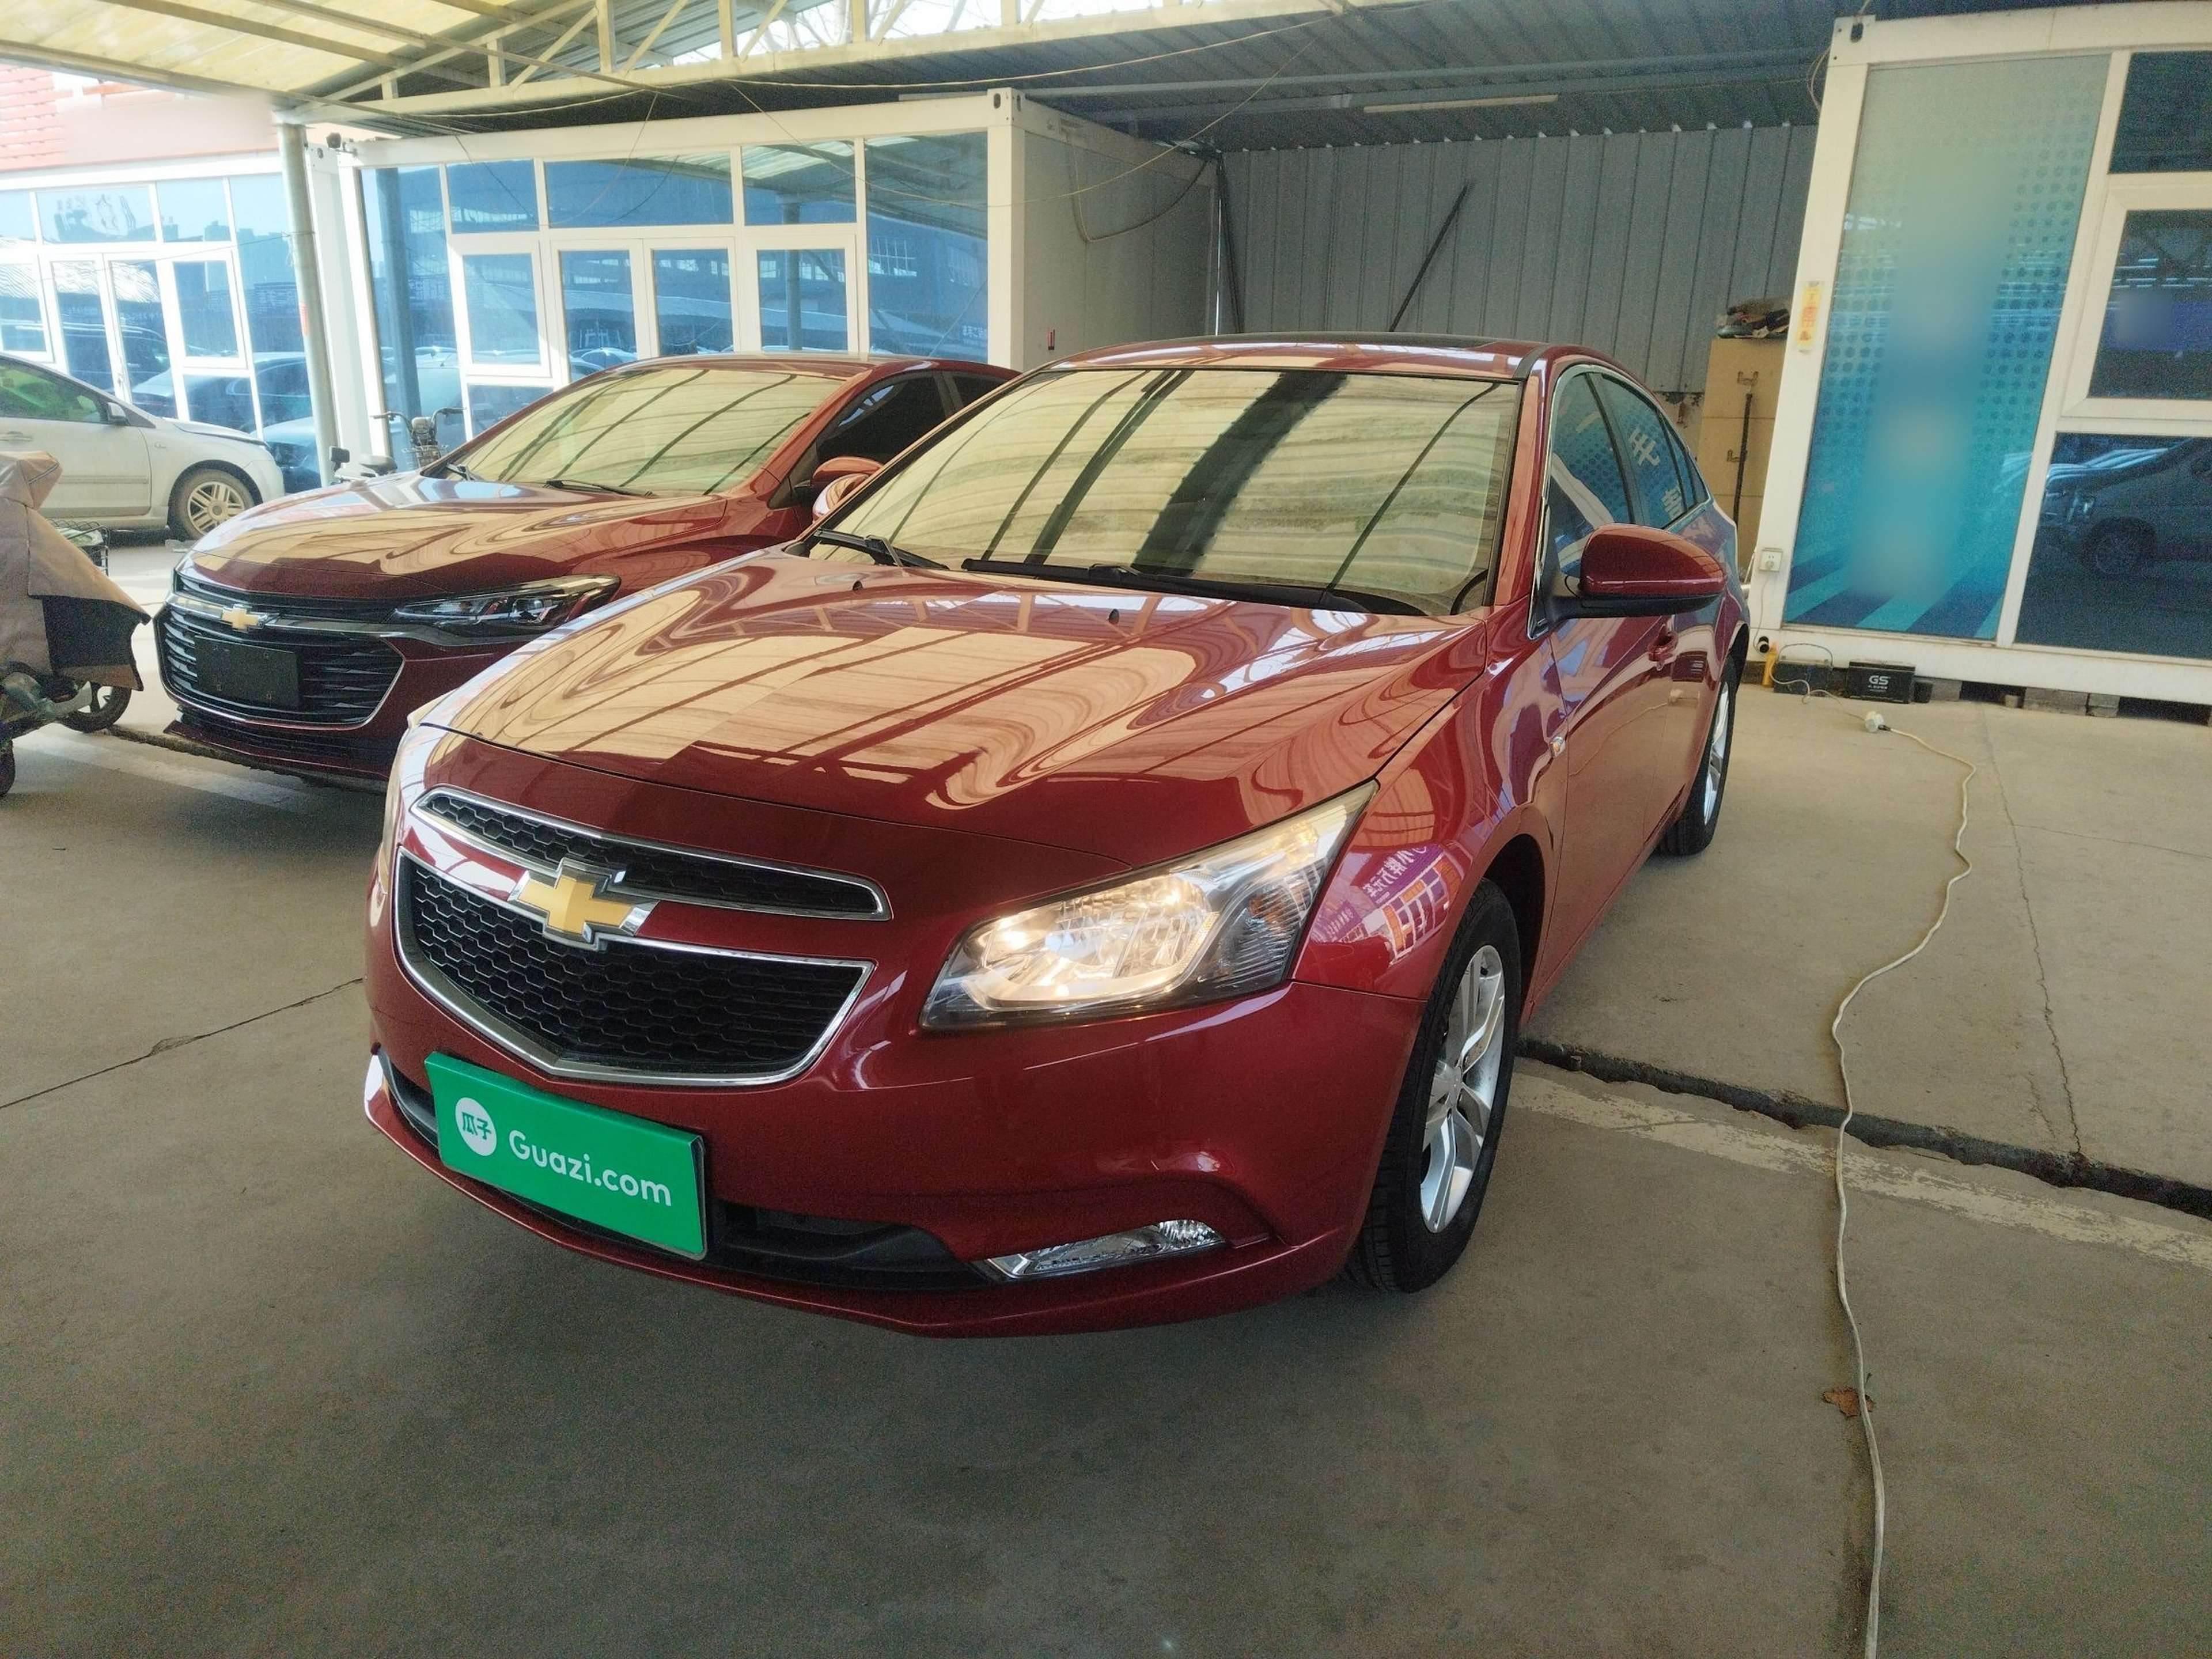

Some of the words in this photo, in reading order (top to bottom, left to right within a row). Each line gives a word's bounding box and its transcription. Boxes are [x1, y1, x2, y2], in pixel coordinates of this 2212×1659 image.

[1869, 675, 1889, 685] GS
[461, 1111, 492, 1141] 瓜子
[509, 1130, 672, 1206] Guazi.com
